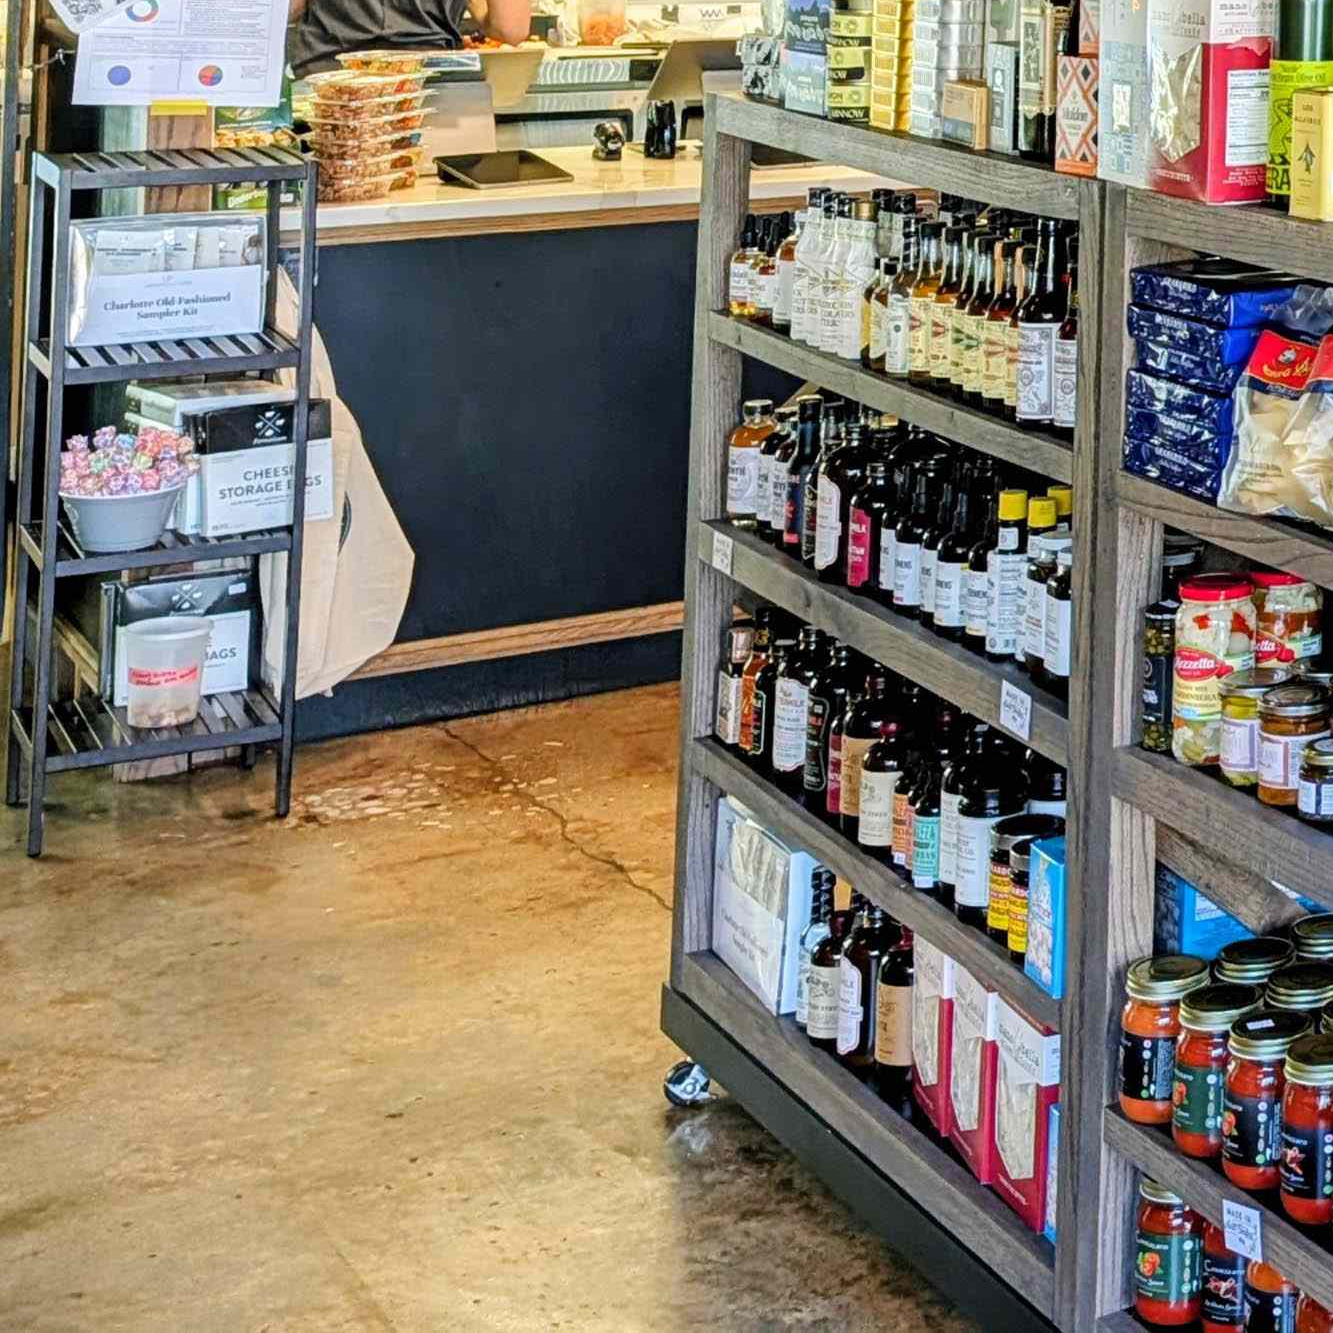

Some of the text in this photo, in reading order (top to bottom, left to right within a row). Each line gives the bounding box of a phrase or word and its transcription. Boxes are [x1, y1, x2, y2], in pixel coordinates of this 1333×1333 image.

[104, 292, 231, 311] Charlotte Old Fashioned
[136, 307, 198, 321] Sampler Kit
[219, 480, 284, 500] STORAGE
